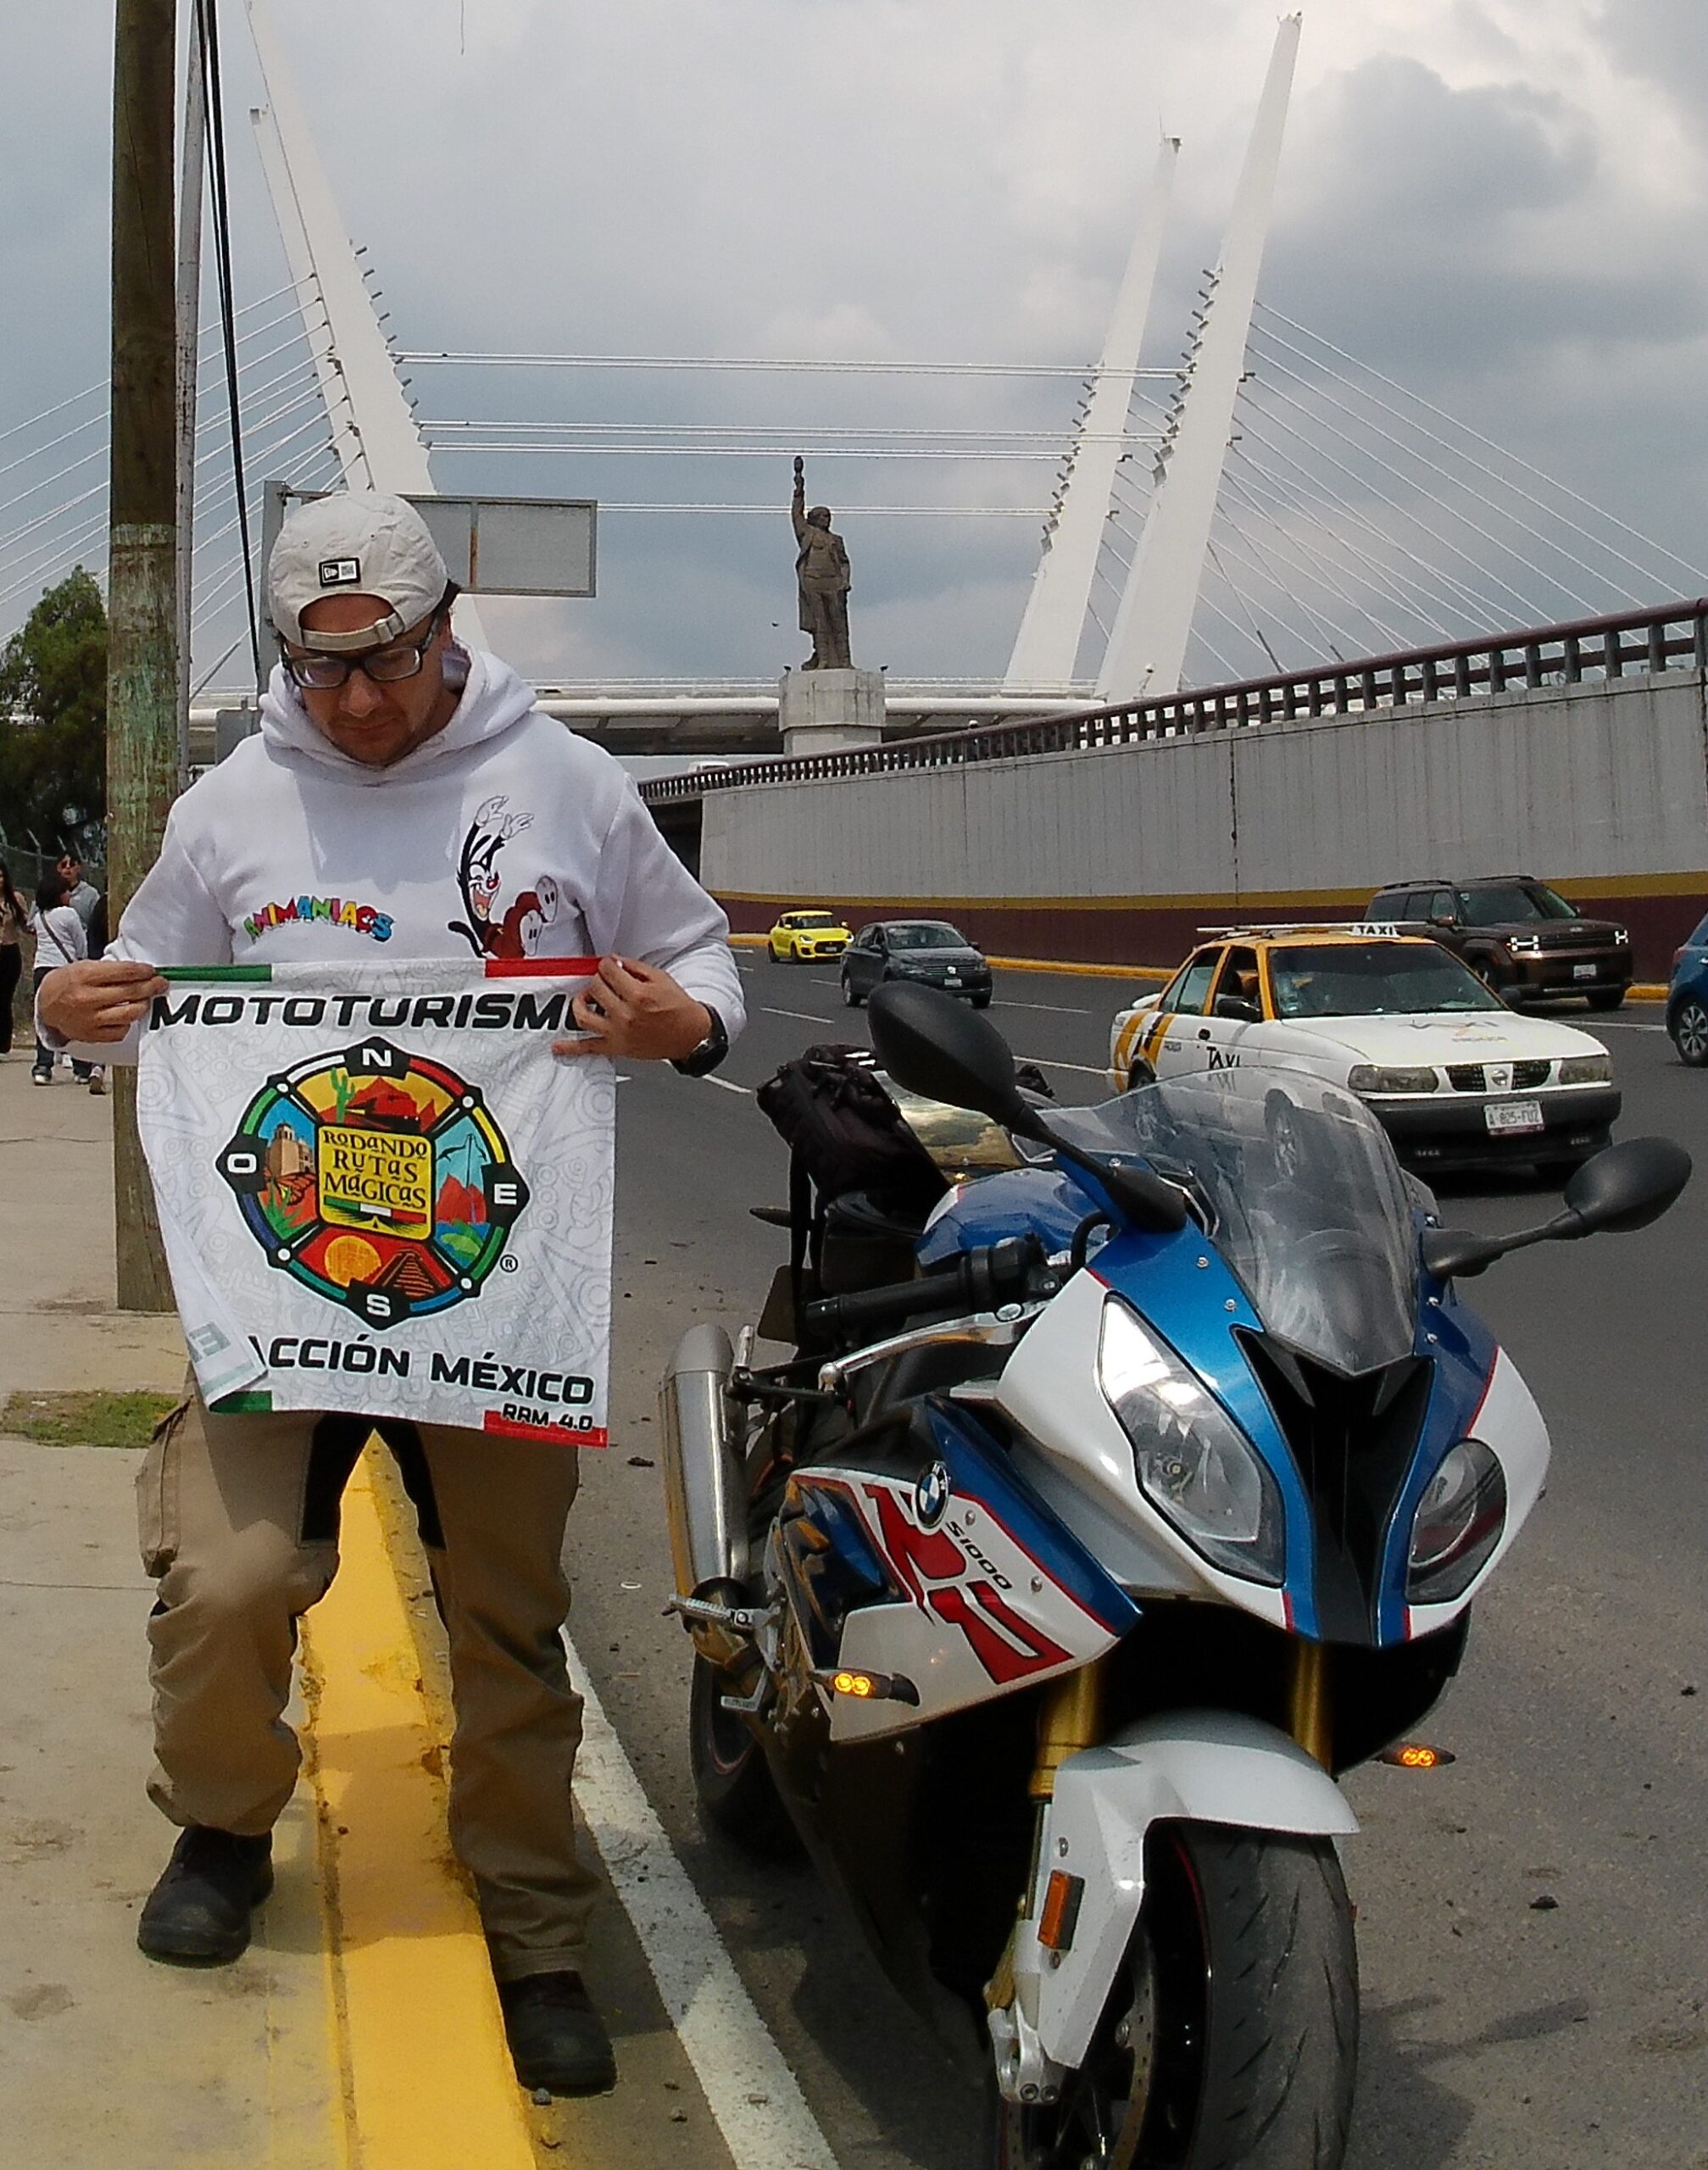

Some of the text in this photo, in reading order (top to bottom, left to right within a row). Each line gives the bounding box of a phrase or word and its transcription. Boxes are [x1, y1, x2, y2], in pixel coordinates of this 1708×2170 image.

[243, 895, 393, 944] ANIMANIACS
[1357, 925, 1393, 936] TAXI
[362, 1048, 392, 1067] N
[227, 1153, 257, 1174] O
[494, 1183, 517, 1205] E
[366, 1294, 391, 1317] S
[248, 1333, 409, 1377] CCIÓN
[431, 1352, 594, 1405] MÉXICO
[502, 1403, 593, 1431] RRM 4.0
[945, 1521, 1013, 1590] S1000
